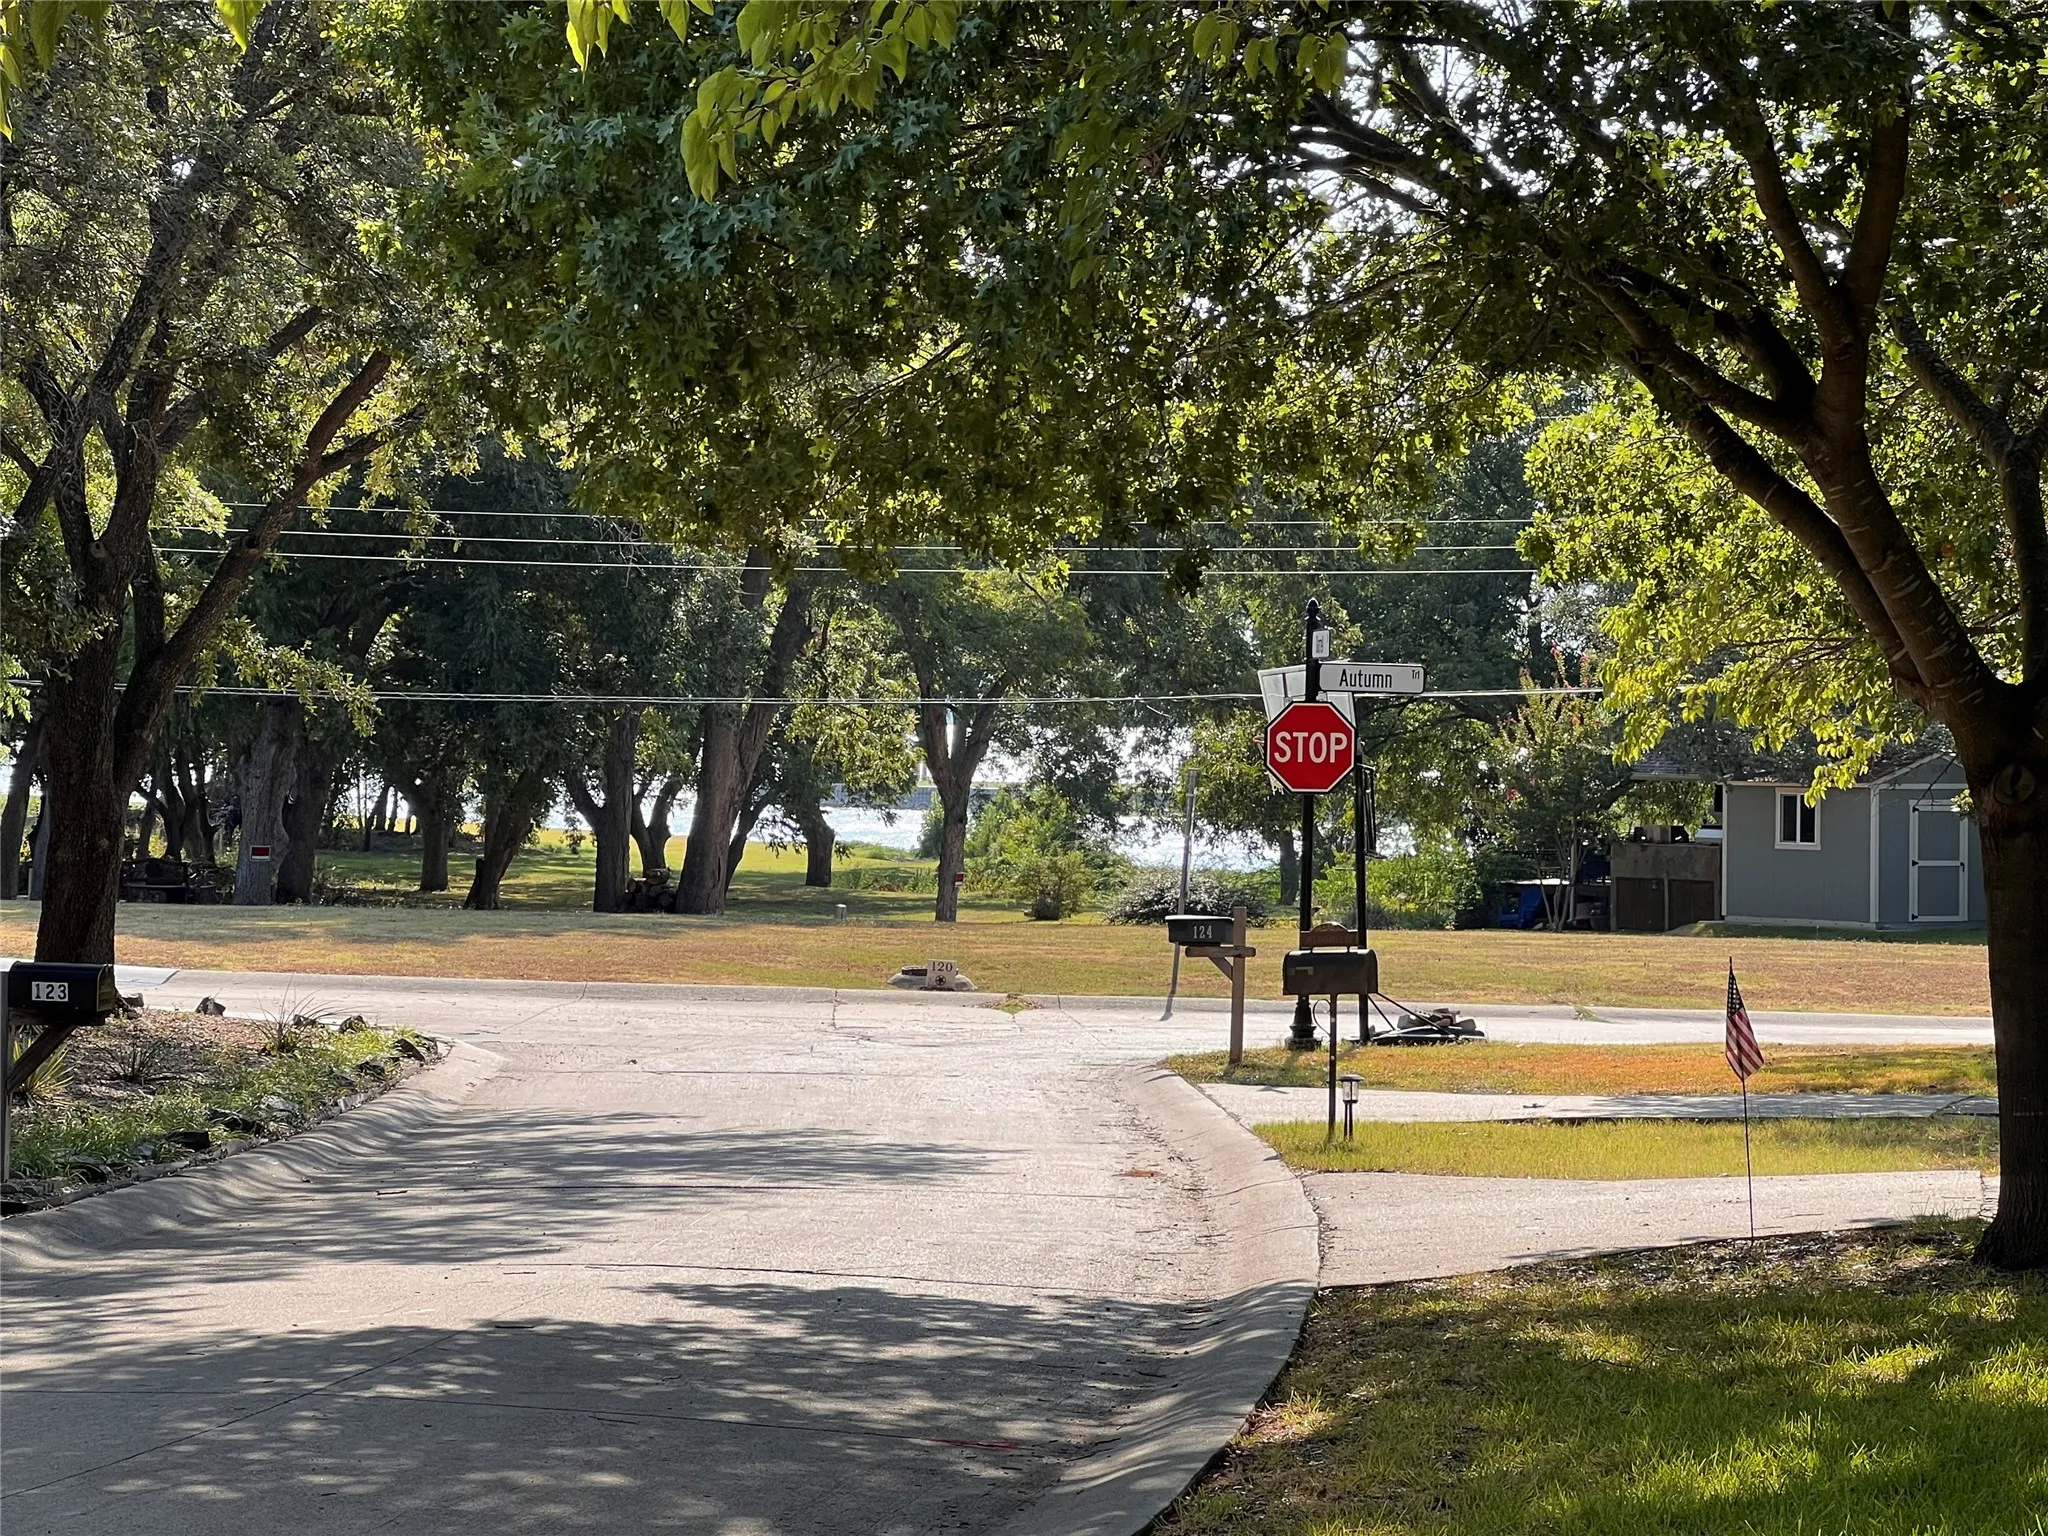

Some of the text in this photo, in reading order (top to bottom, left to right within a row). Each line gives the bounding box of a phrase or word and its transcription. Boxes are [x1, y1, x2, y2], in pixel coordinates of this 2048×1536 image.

[1339, 668, 1393, 689] Autumn
[1274, 731, 1348, 764] STOP
[1192, 925, 1213, 939] 124
[931, 961, 953, 972] 120
[34, 983, 67, 1000] 123
